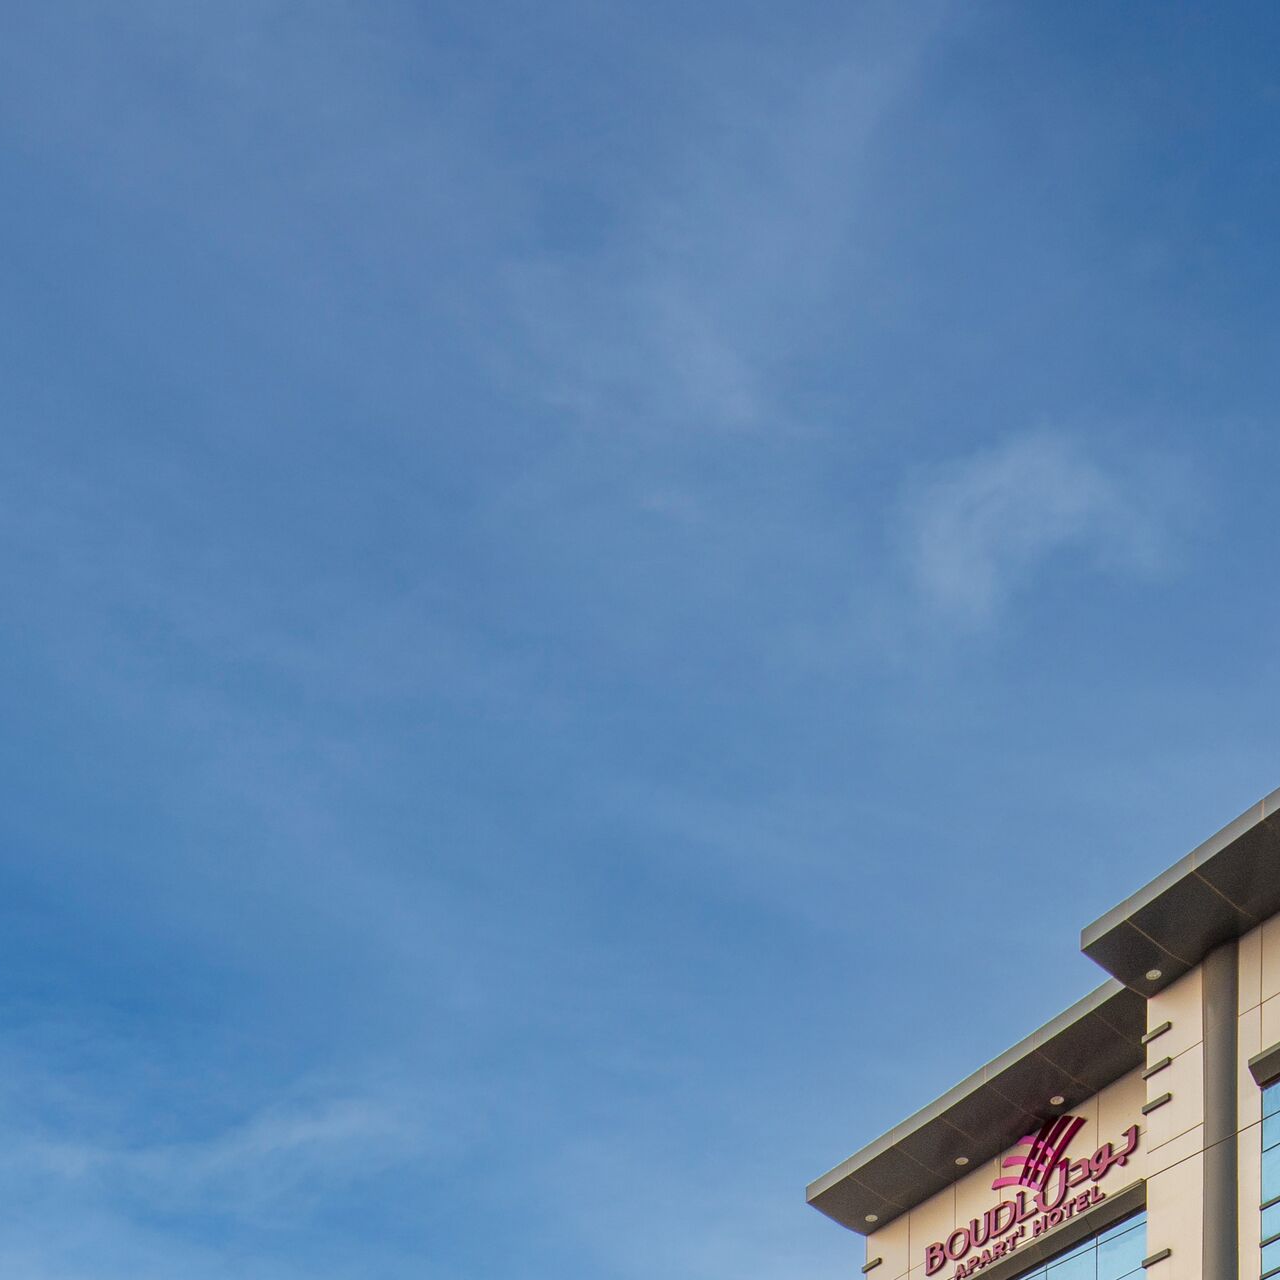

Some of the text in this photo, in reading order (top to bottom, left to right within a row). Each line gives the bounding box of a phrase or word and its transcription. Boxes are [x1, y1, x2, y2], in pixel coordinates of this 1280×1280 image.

[1033, 1124, 1140, 1213] بودل
[925, 1190, 1038, 1276] BOUDL
[1032, 1186, 1106, 1238] HOTEL
